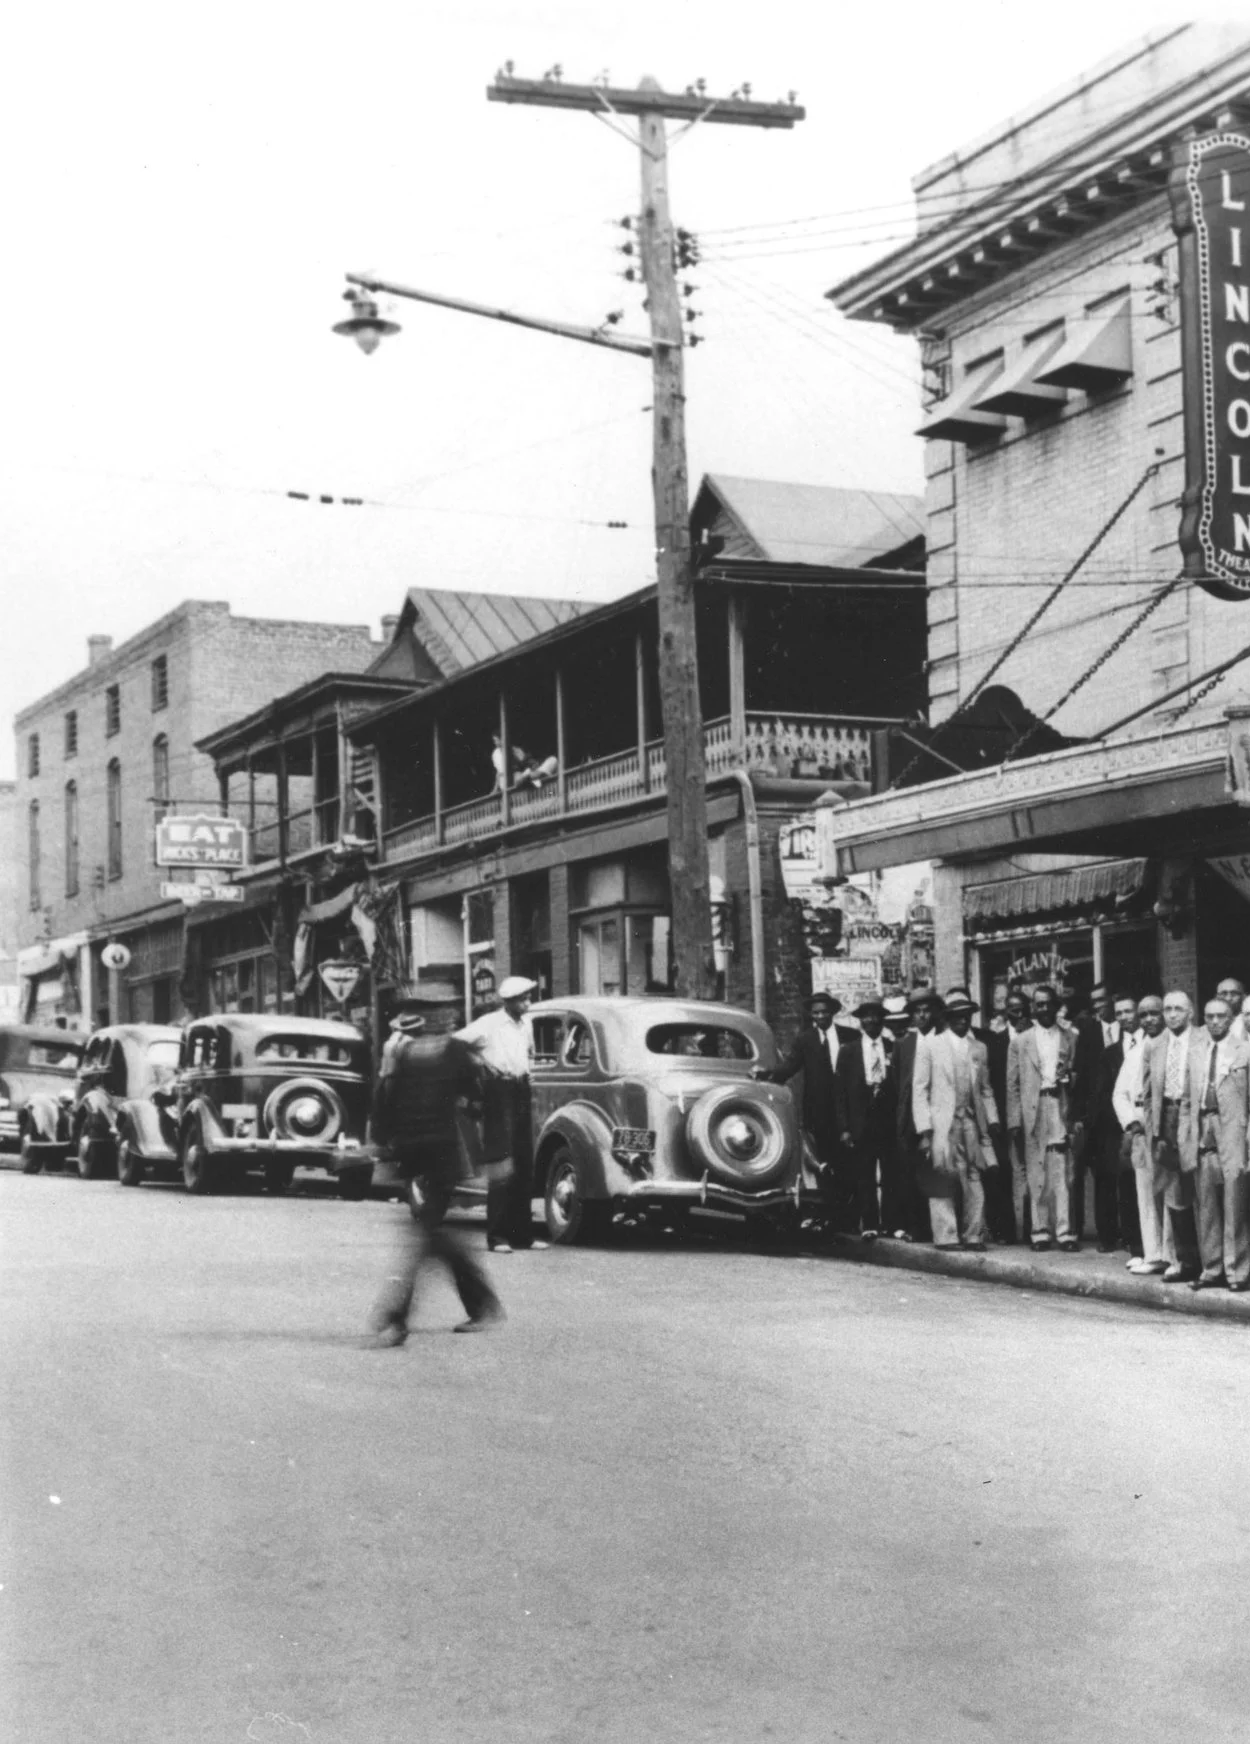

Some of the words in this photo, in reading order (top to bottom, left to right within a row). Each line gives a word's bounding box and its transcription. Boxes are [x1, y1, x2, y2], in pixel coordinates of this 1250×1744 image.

[169, 824, 234, 844] EAT
[850, 925, 901, 940] LINCOL
[1007, 952, 1071, 984] ATLANTIC
